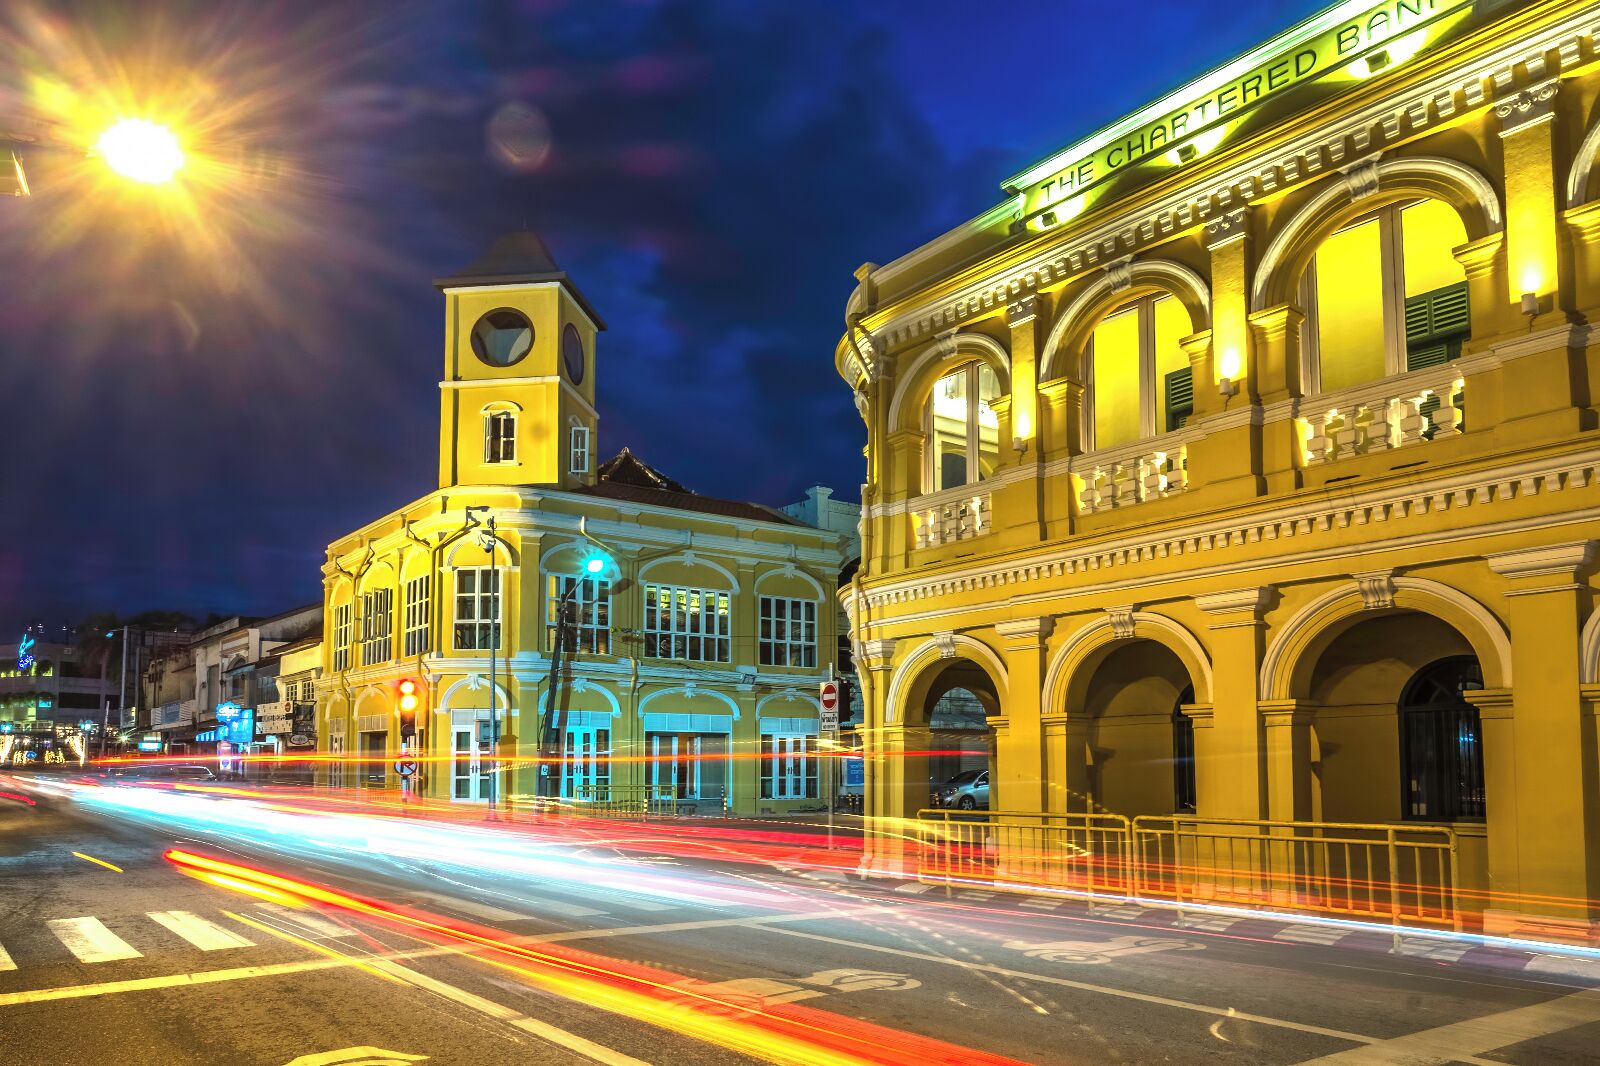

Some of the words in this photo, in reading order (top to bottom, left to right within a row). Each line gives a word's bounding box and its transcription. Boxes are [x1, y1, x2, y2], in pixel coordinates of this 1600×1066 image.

[1041, 160, 1094, 201] THE
[1106, 49, 1317, 168] CHARTERED
[1336, 0, 1435, 56] BAN
